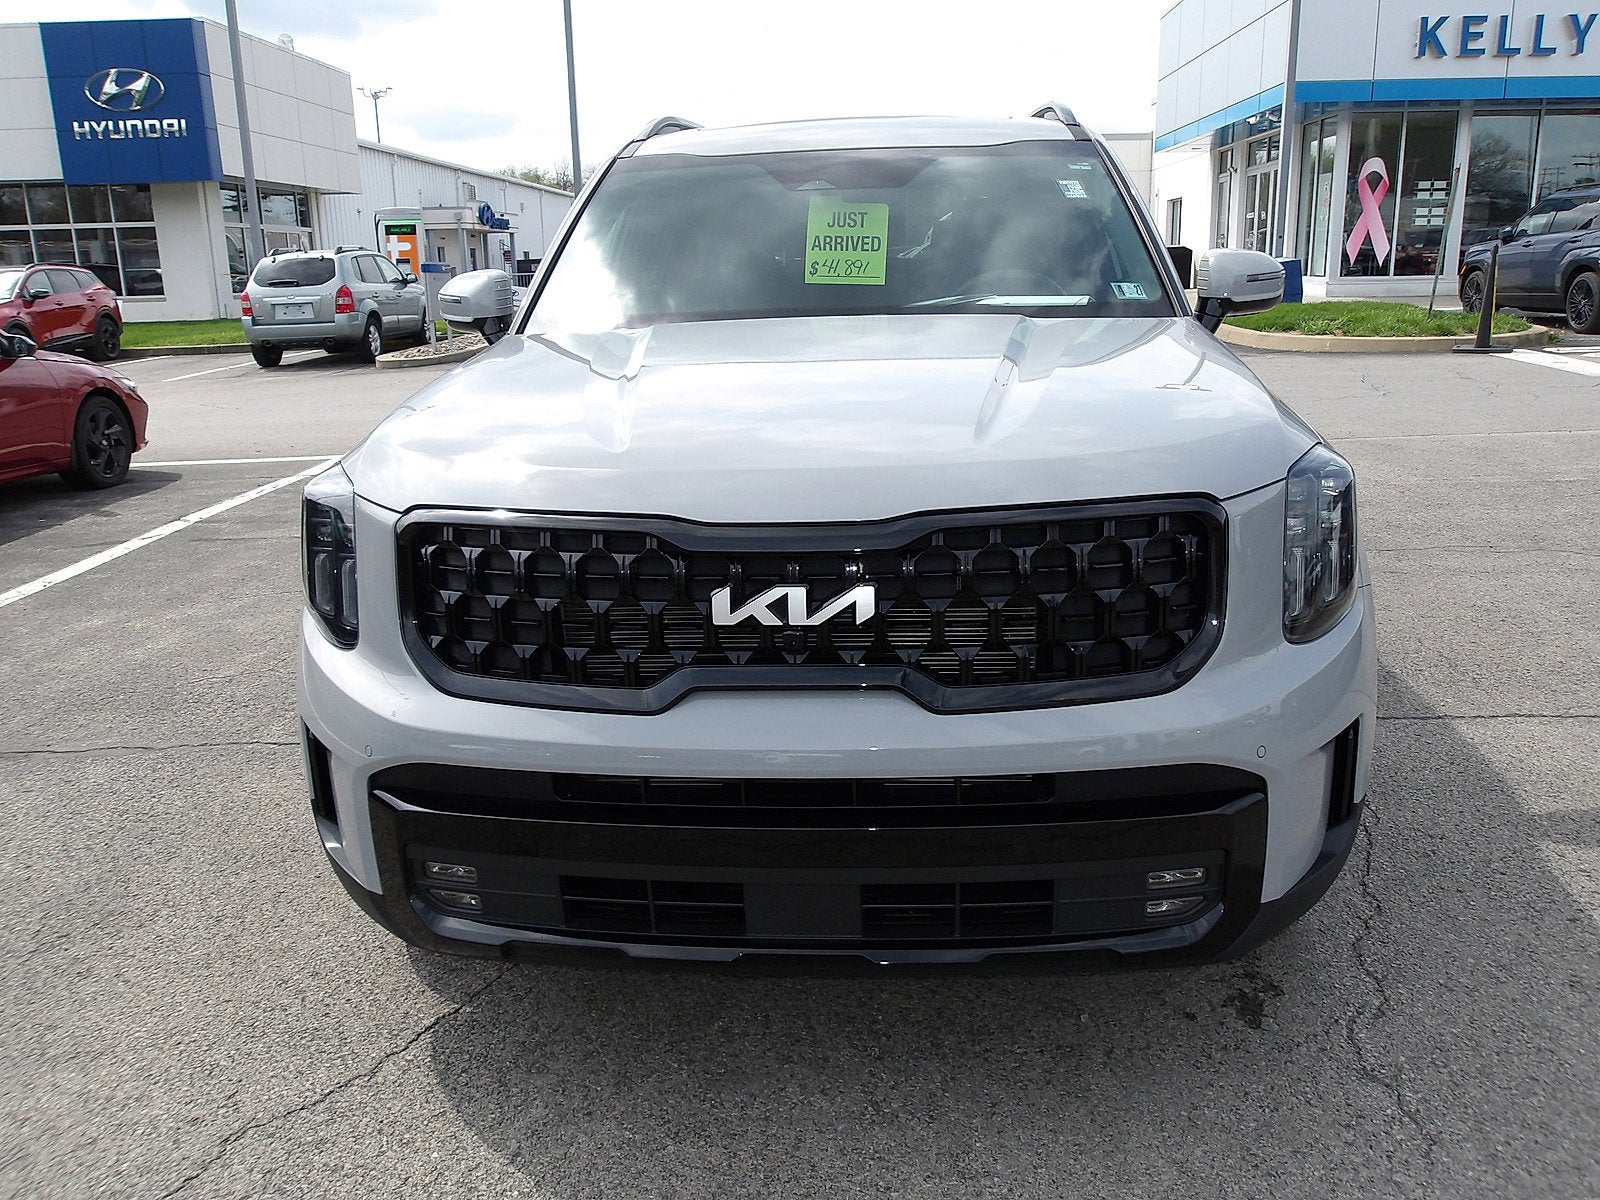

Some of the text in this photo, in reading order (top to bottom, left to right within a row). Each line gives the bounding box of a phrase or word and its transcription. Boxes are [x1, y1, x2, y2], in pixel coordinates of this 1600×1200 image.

[1415, 13, 1598, 58] KELLY
[72, 119, 188, 140] HYUNDAI
[827, 211, 868, 228] JUST
[811, 235, 882, 252] ARRIVED
[711, 585, 876, 626] KIA
